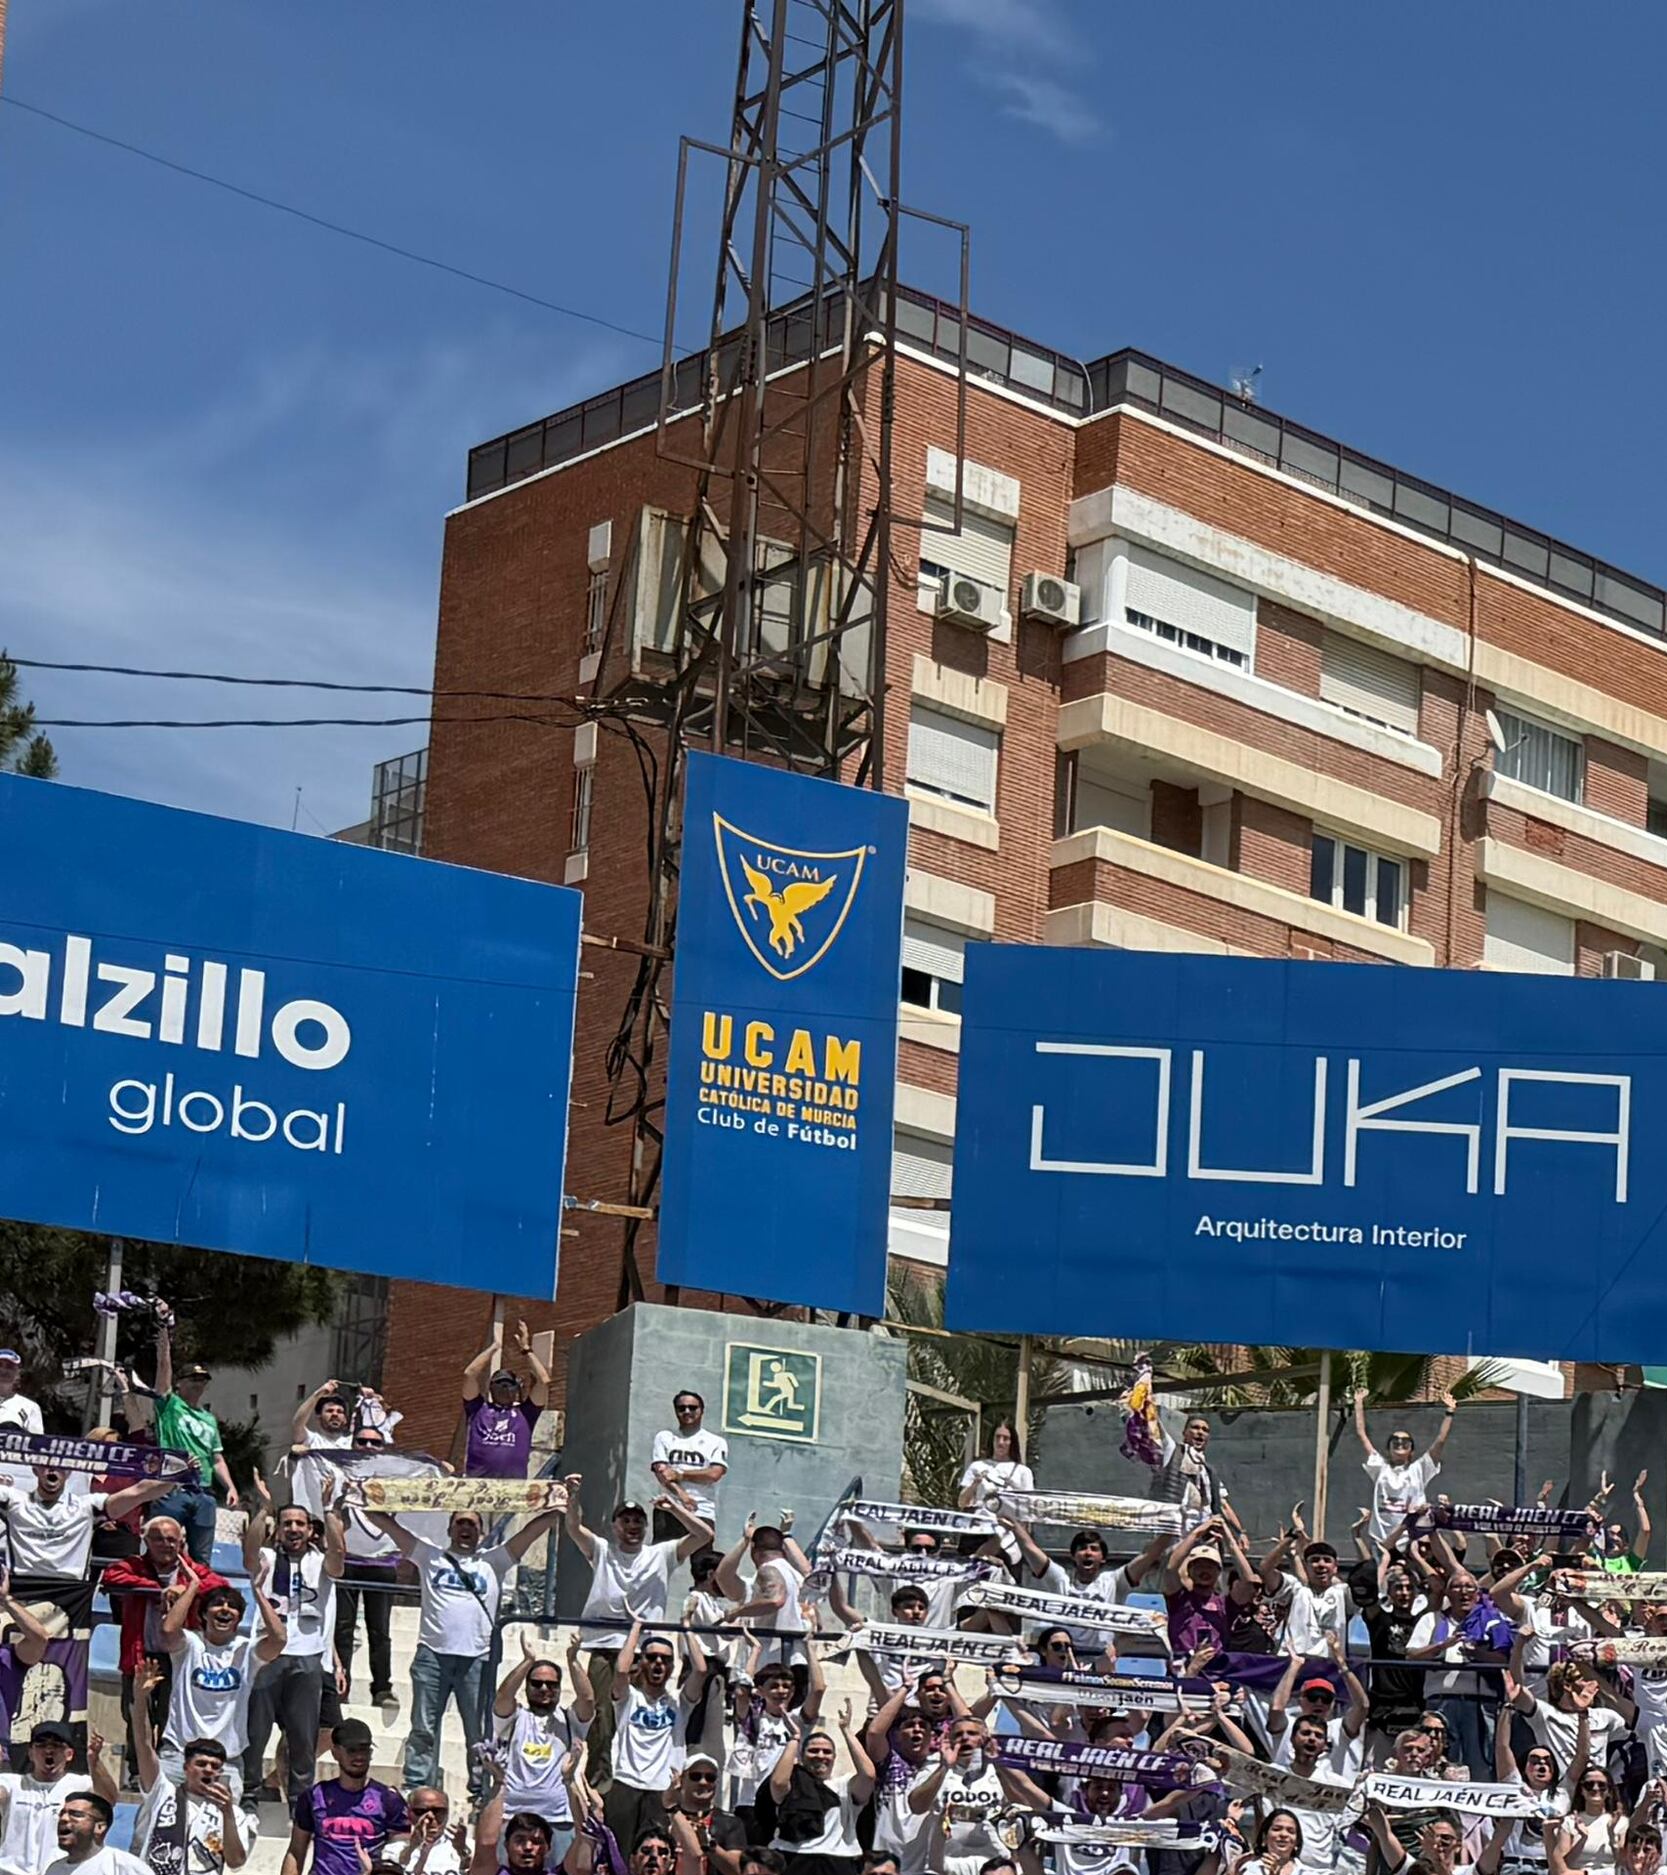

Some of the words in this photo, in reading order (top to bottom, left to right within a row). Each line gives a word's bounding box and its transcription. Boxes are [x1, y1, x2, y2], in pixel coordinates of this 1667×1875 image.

[757, 855, 819, 883] UCAM
[701, 1012, 861, 1083] UCAM
[700, 1061, 860, 1111] UNIVERSIDAD
[109, 1073, 345, 1154] global
[700, 1088, 771, 1115] CATÓLICA
[776, 1103, 796, 1118] DE
[801, 1106, 857, 1129] MURCIA
[1030, 1041, 1631, 1202] DUKA
[697, 1107, 746, 1130] Club
[754, 1118, 779, 1137] de
[787, 1116, 857, 1150] Fútbol
[1195, 1215, 1363, 1244] Arquitectura
[1372, 1224, 1467, 1249] Interior
[1003, 1590, 1056, 1614] REAL
[869, 1630, 924, 1649] REAL
[1005, 1736, 1065, 1760] REAL
[1138, 1754, 1167, 1772] CF
[1373, 1782, 1423, 1801] REAL
[1429, 1786, 1484, 1808] JAÉN
